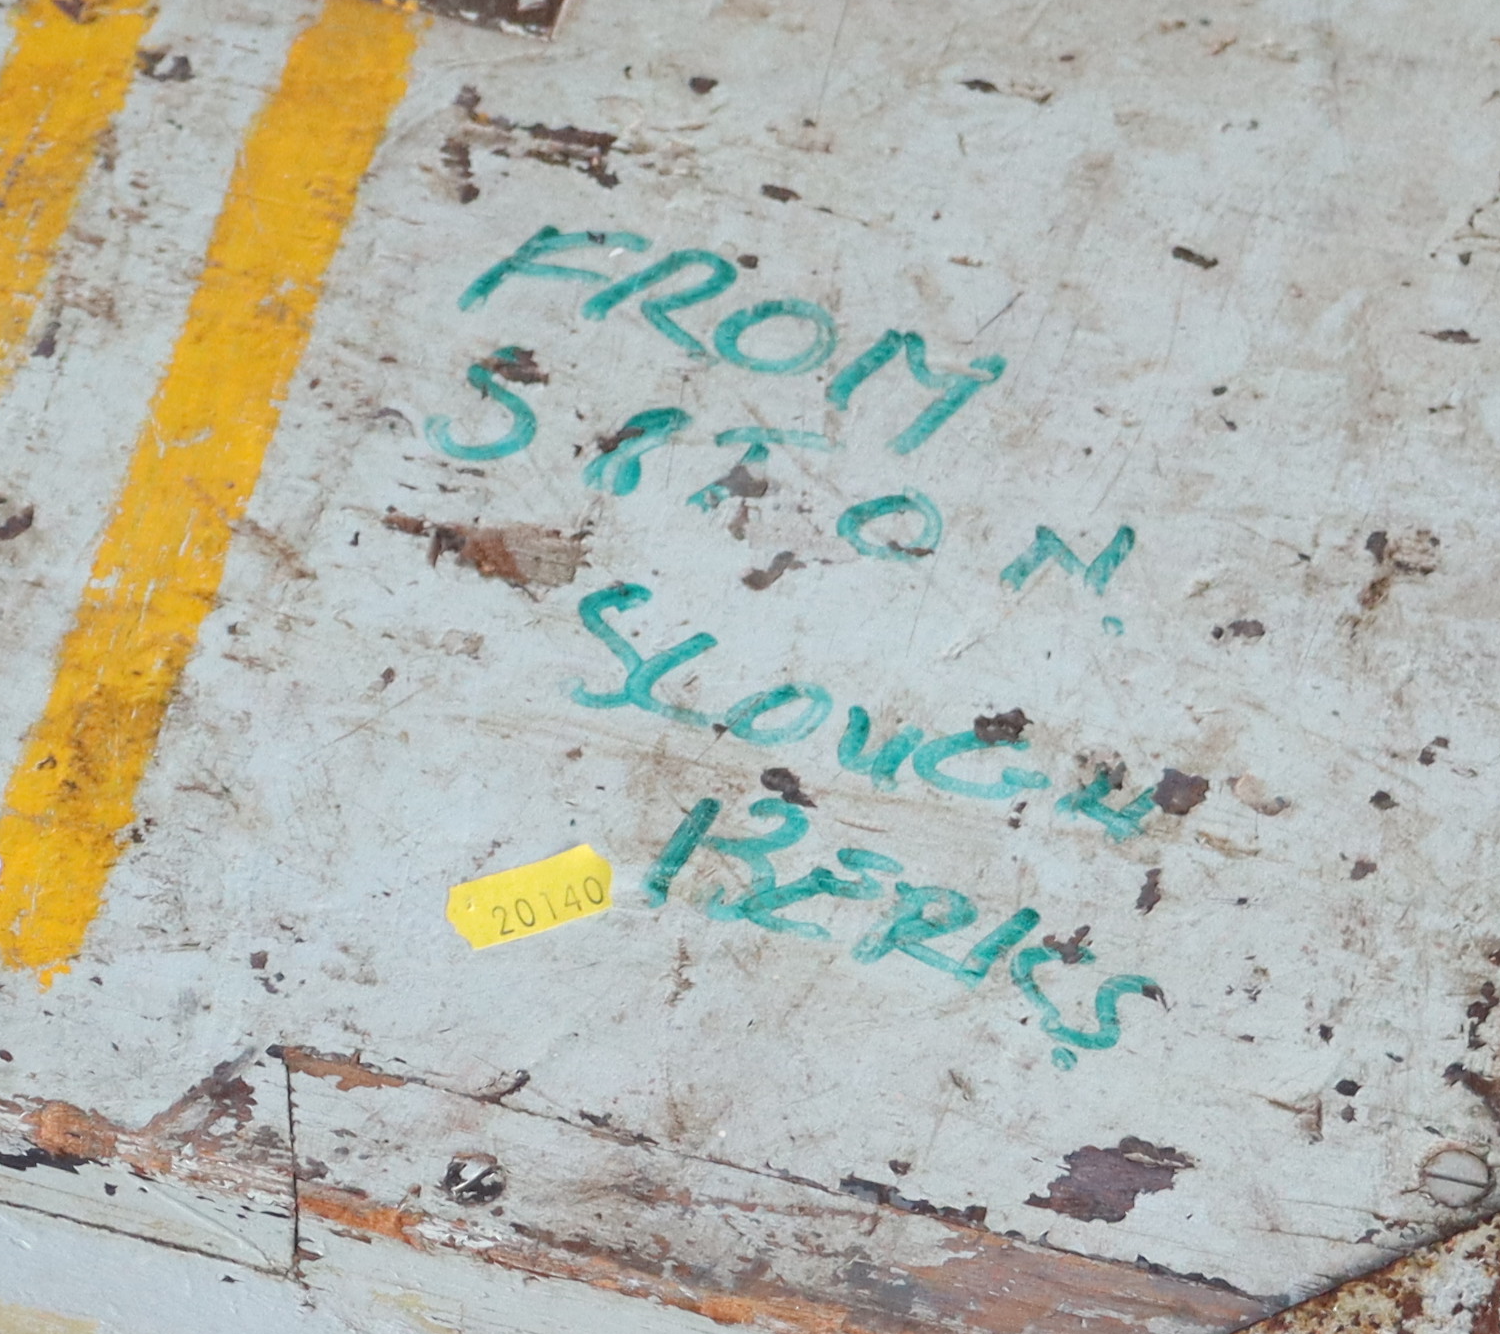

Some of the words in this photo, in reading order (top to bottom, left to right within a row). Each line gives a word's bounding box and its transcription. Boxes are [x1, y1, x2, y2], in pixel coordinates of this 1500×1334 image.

[460, 225, 1004, 455] FROM
[562, 584, 1168, 844] SLOUGH
[492, 876, 604, 936] 20140
